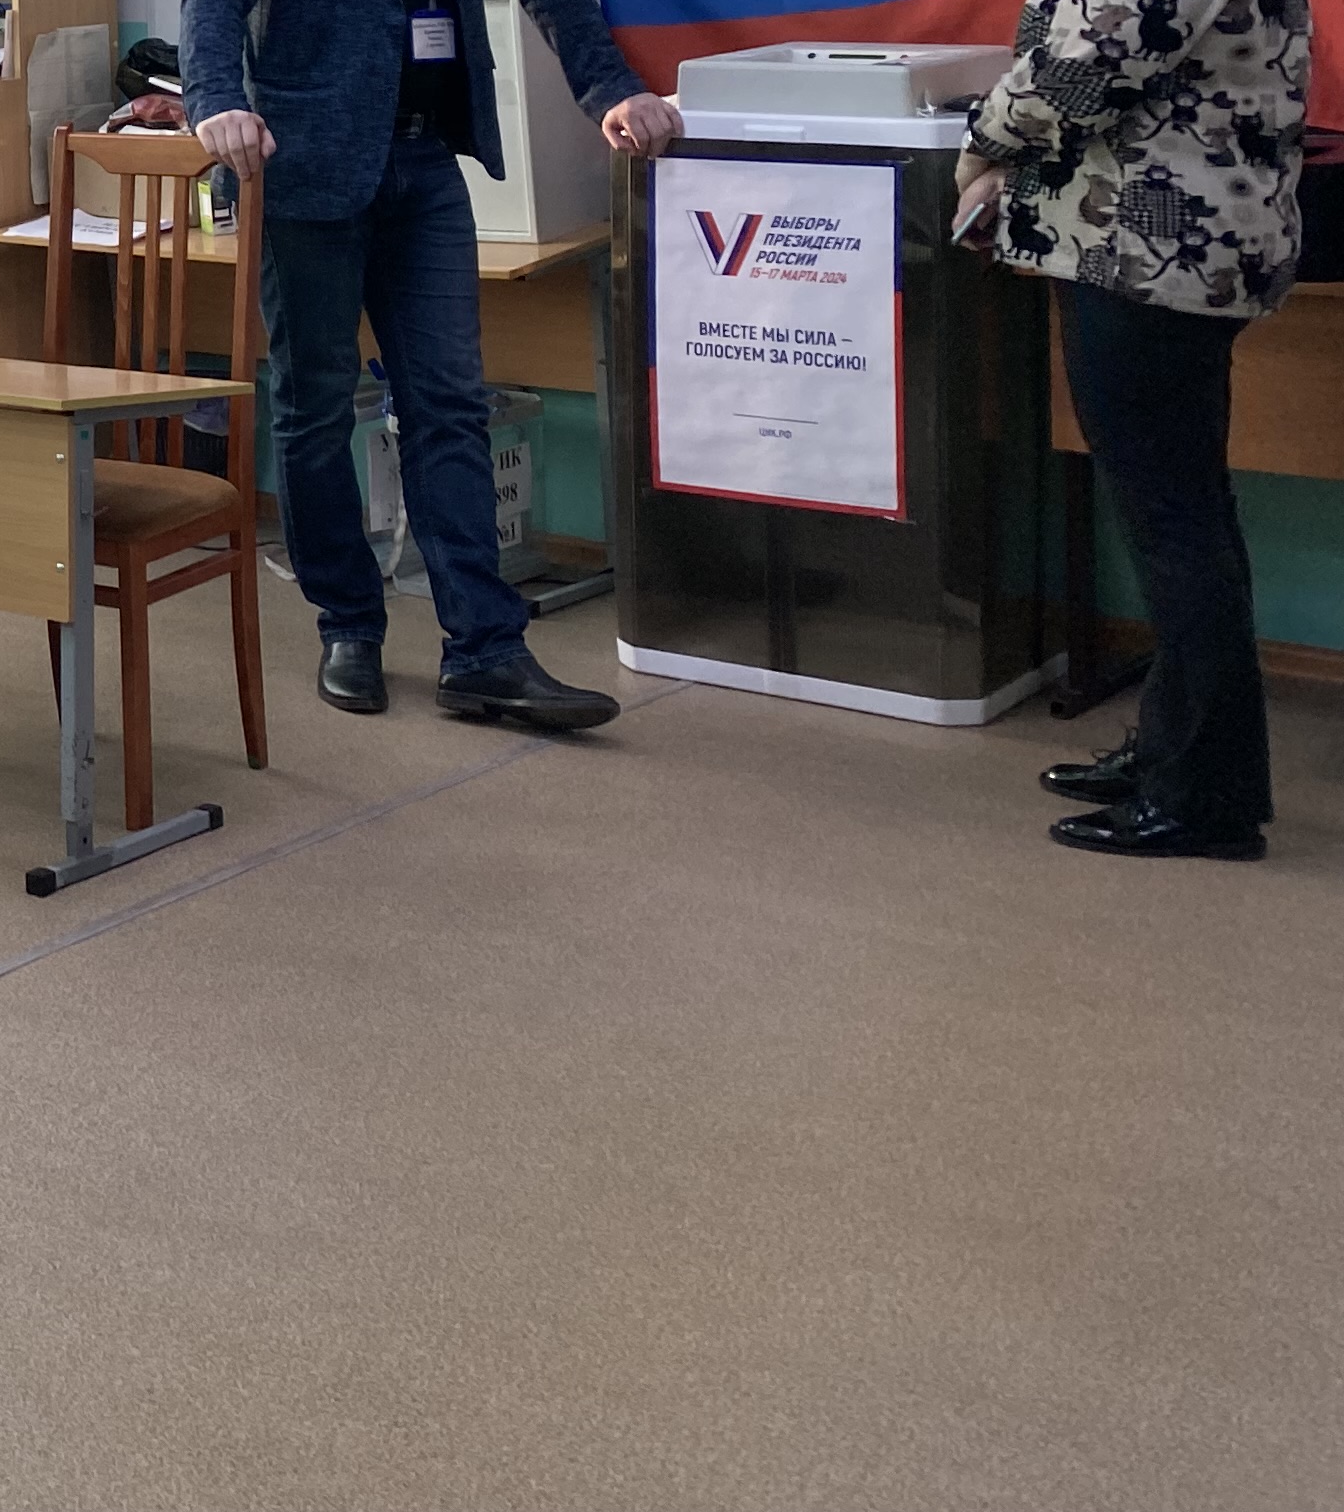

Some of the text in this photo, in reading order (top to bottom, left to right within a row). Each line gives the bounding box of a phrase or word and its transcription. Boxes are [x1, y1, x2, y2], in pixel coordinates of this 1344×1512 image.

[770, 215, 841, 232] ВЫБОРЫ
[762, 233, 862, 251] ПРЕЗИДЕНТА
[756, 251, 818, 266] РОССИИ
[780, 269, 818, 283] МАРТА
[819, 272, 847, 284] 2024
[699, 321, 758, 341] ВМЕСТЕ
[762, 326, 789, 343] МЫ
[794, 329, 837, 346] СИЛА
[686, 341, 866, 371] ГОЛОСУЕМ ЗА РОССИЮ!
[499, 446, 522, 471] ИК
